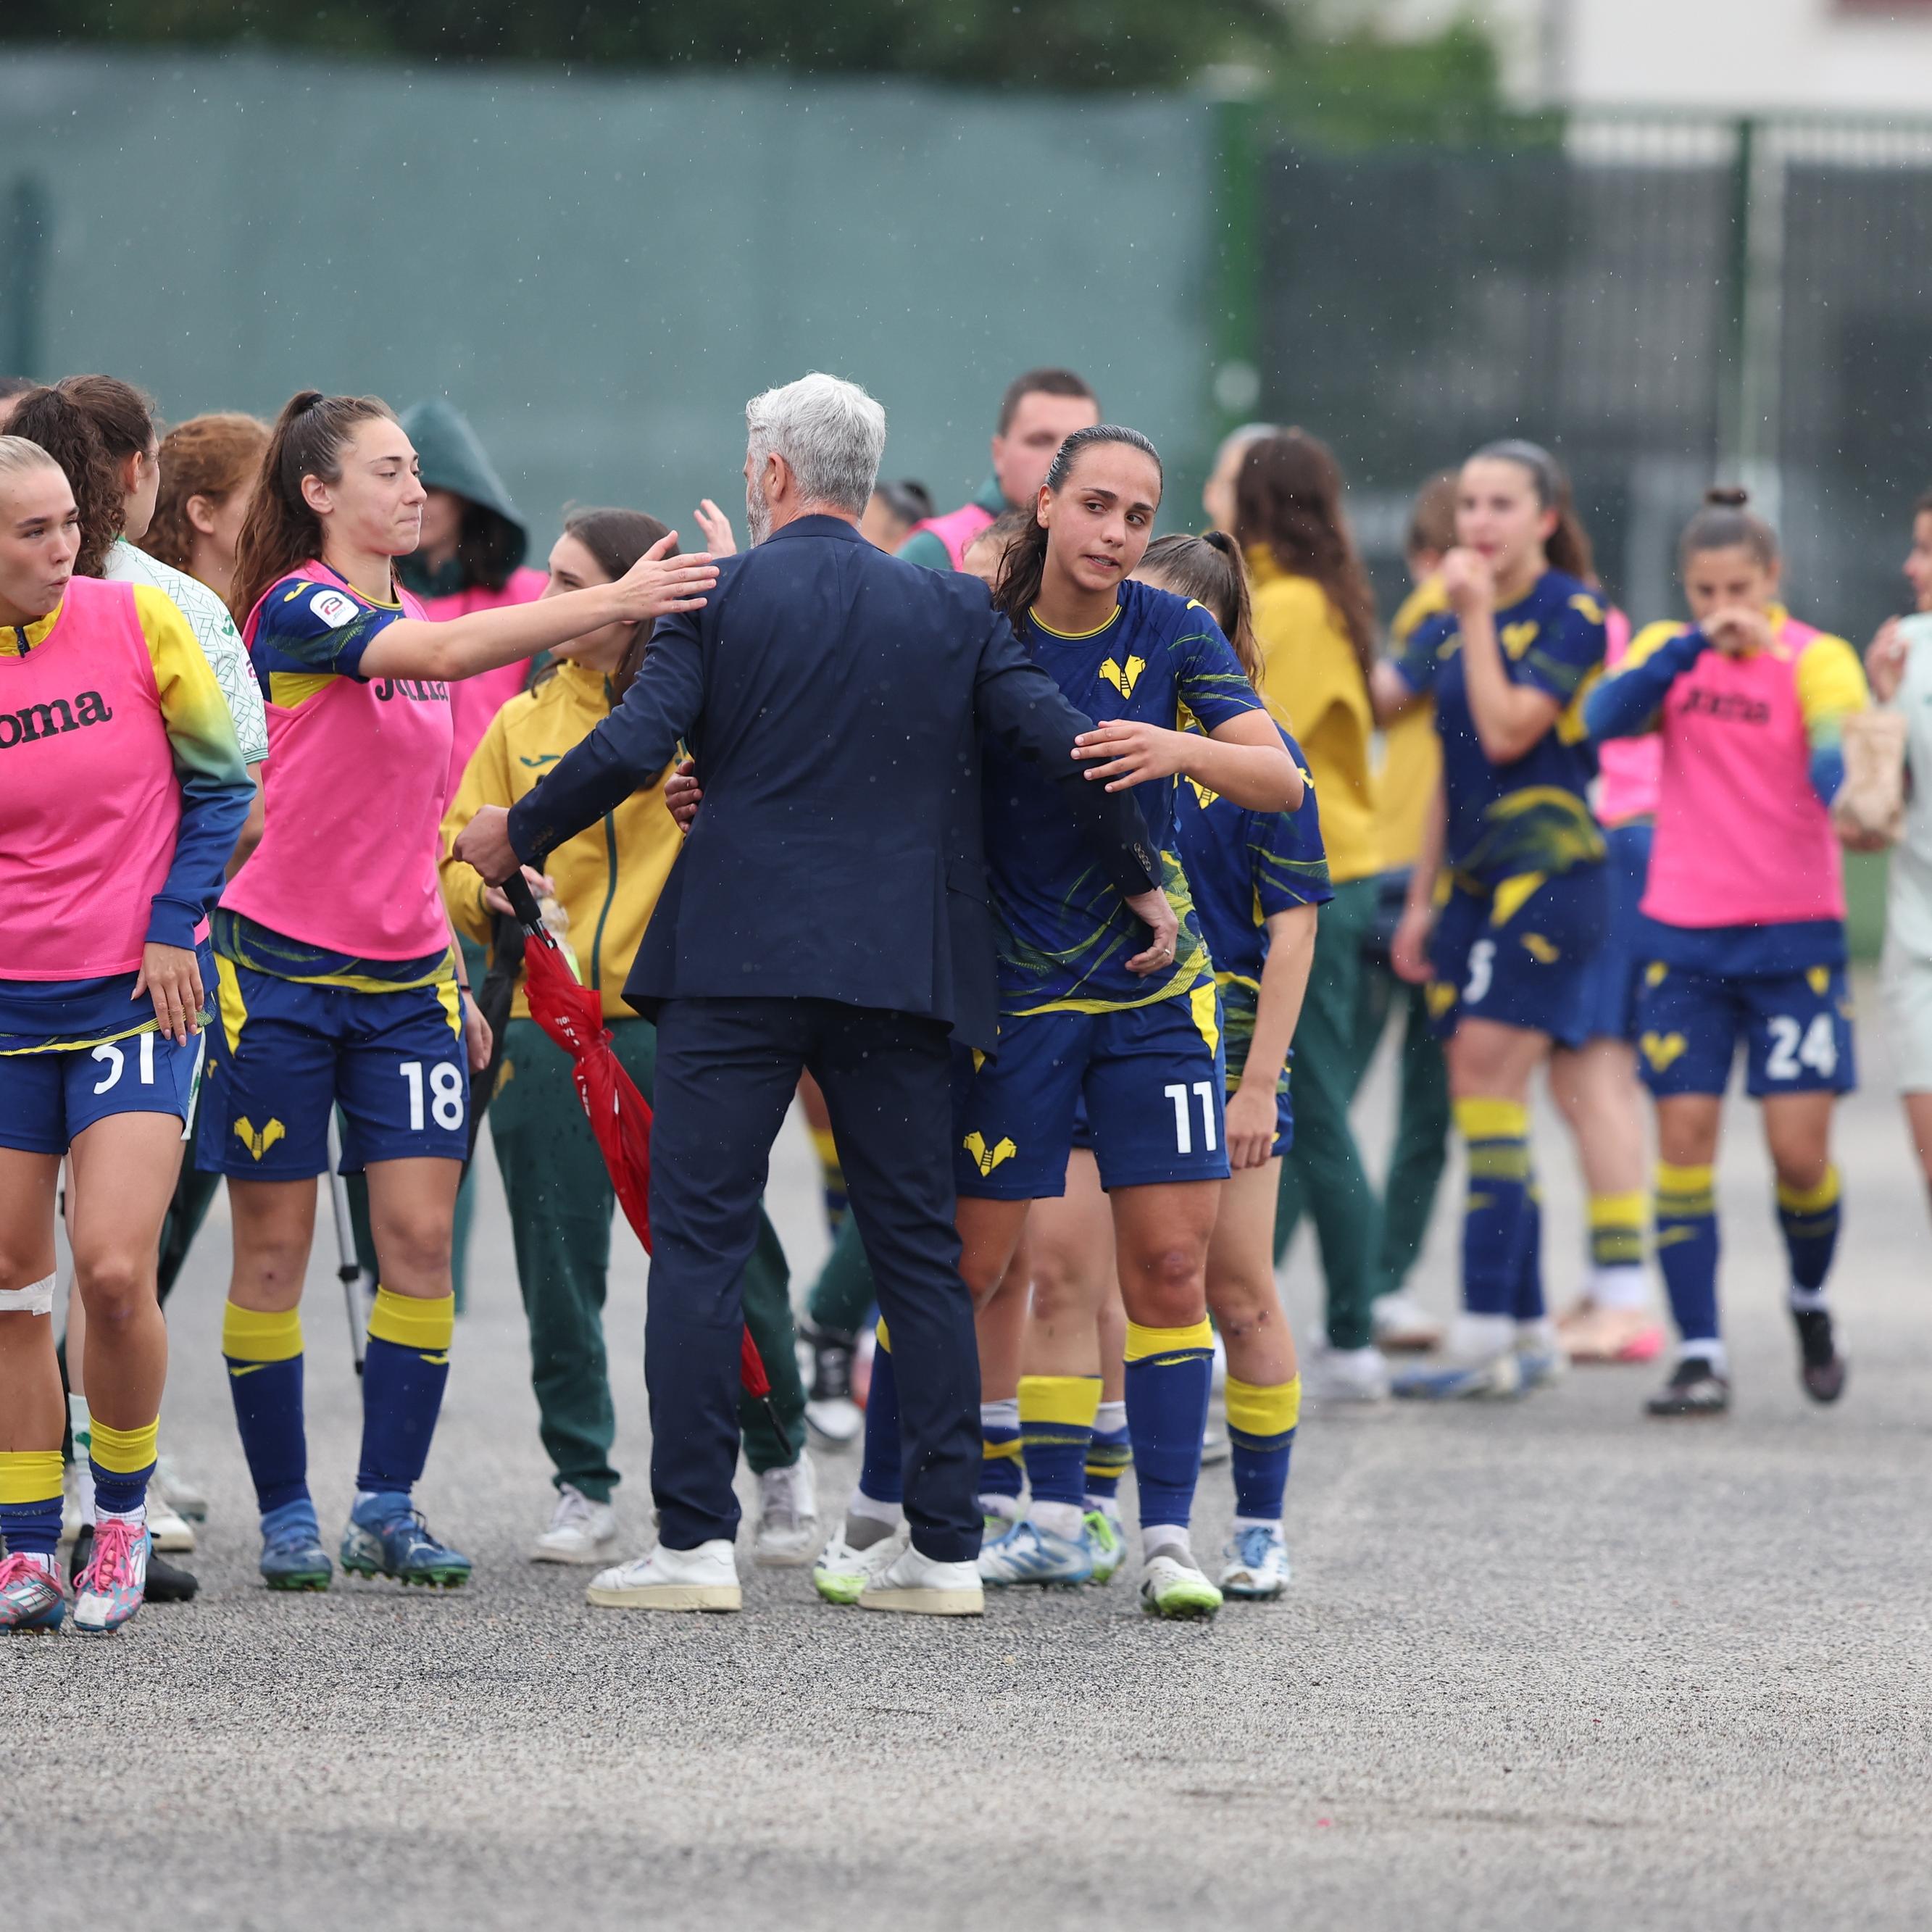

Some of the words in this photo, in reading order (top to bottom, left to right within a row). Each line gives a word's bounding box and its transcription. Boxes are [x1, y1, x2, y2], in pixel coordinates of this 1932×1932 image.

[1766, 1013, 1839, 1080] 24
[399, 1061, 465, 1131] 18
[1164, 1080, 1217, 1154] 11
